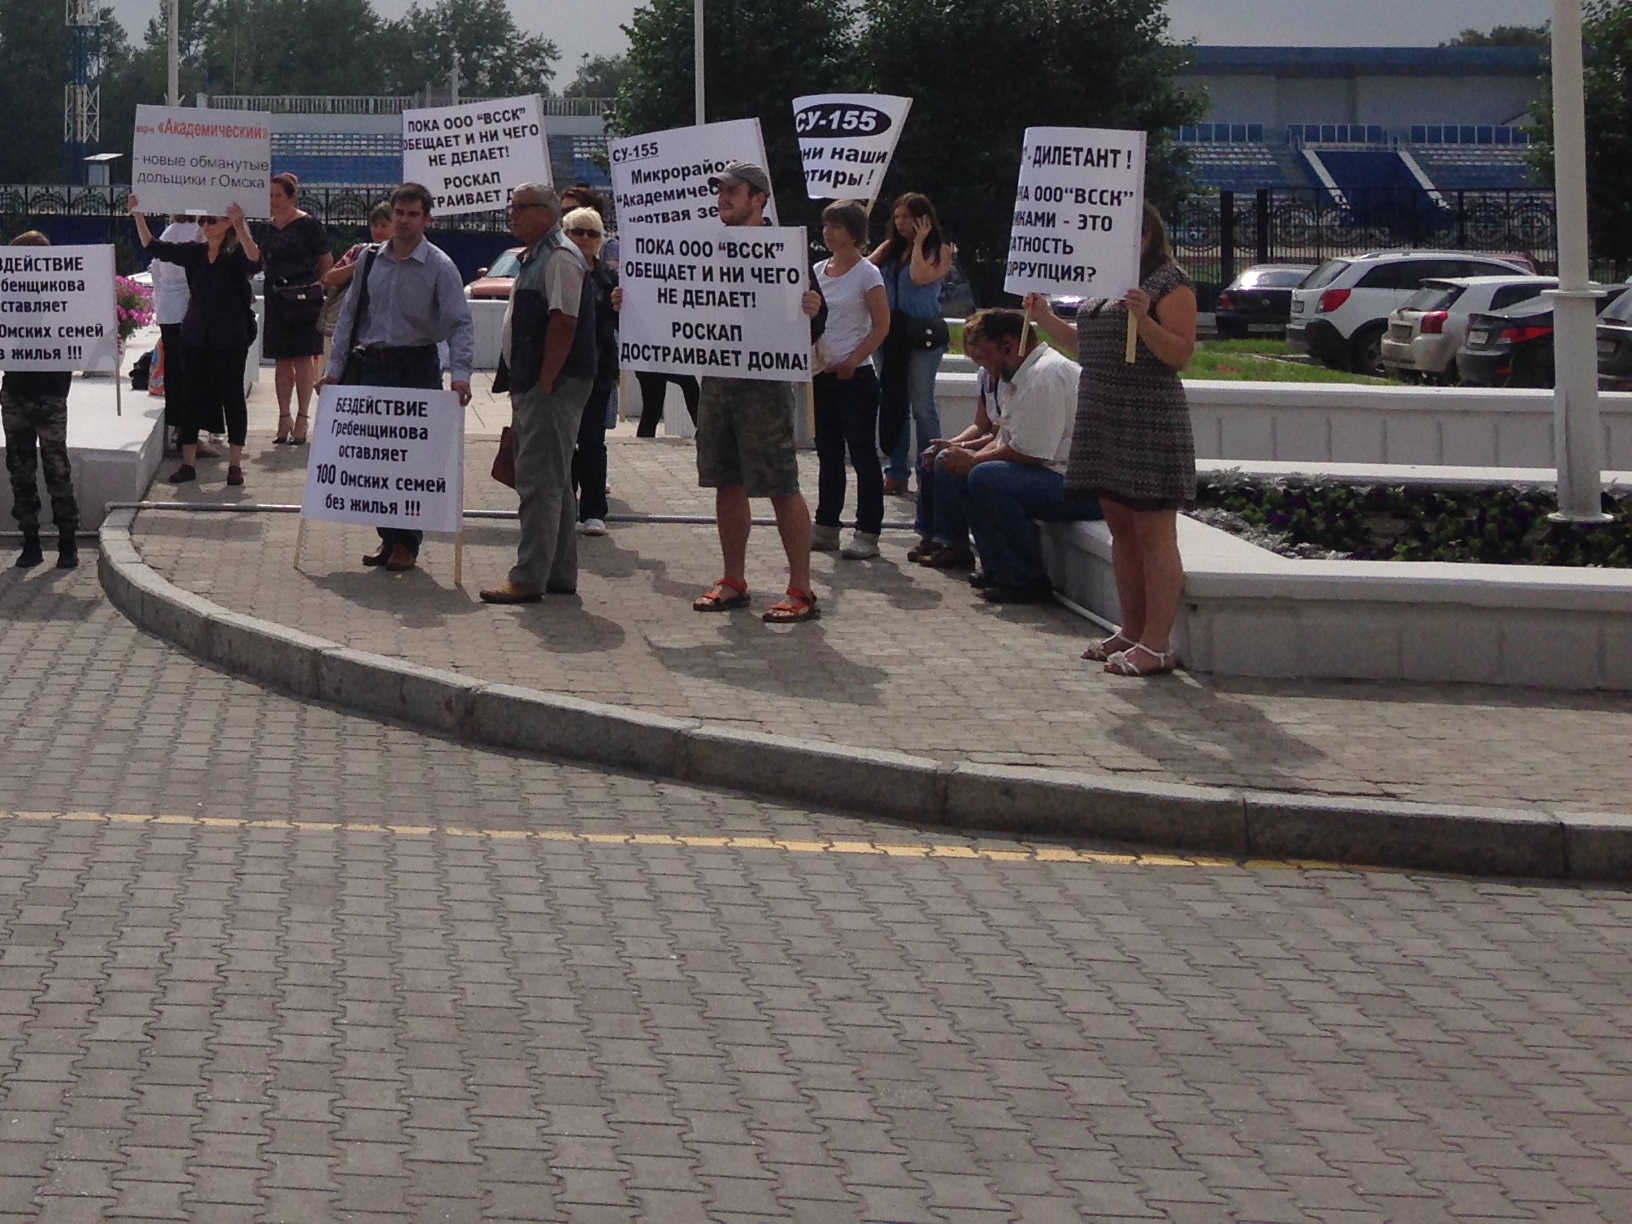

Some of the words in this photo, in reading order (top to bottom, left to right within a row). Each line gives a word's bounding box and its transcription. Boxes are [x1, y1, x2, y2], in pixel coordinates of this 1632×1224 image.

[408, 120, 439, 133] ПОКА
[444, 115, 473, 130] ООО
[796, 110, 877, 133] СУ-155
[466, 133, 475, 145] И
[480, 130, 499, 143] НИ
[503, 124, 538, 139] ЧЕГО
[429, 154, 447, 167] НЕ
[451, 146, 510, 167] ДЕЛАЕТ!
[613, 142, 658, 162] СУ-155
[803, 147, 824, 161] ни
[830, 147, 888, 163] наши
[1033, 146, 1121, 169] ДИЛЕТАНТ
[1127, 150, 1131, 169] !
[143, 155, 185, 166] новые
[190, 156, 268, 172] обманутые
[631, 159, 737, 185] Микрорайо
[137, 172, 206, 186] дольщики
[444, 172, 501, 189] РОСКАП
[805, 169, 863, 189] тиры
[867, 169, 874, 185] !
[431, 190, 501, 209] ТРАИВАЕТ
[617, 186, 719, 208] “Академичес
[1078, 214, 1112, 231] ЭТО
[636, 238, 674, 255] ПОКА
[680, 240, 713, 257] ООО
[1010, 236, 1074, 255] АТНОСТЬ
[625, 261, 696, 282] ОБЕЩАЕТ
[702, 266, 713, 282] И
[720, 267, 744, 283] НИ
[751, 268, 800, 284] ЧЕГО
[658, 288, 677, 304] НЕ
[683, 290, 756, 309] ДЕЛАЕТ!
[58, 323, 103, 337] семей
[672, 322, 742, 342] РОСКАП
[12, 348, 61, 360] жилья
[67, 346, 82, 359] !!!
[621, 343, 741, 367] ДОСТРАИВАЕТ
[748, 351, 808, 371] ДОМА!
[336, 395, 428, 417] БЕЗДЕЙСТВИЕ
[332, 419, 428, 440] Гребенщикова
[339, 444, 408, 462] оставляет
[317, 463, 336, 485] 100
[341, 471, 389, 490] Омских
[396, 477, 446, 493] семей
[326, 494, 344, 510] без
[351, 498, 398, 515] жилья
[405, 501, 420, 516] !!!
